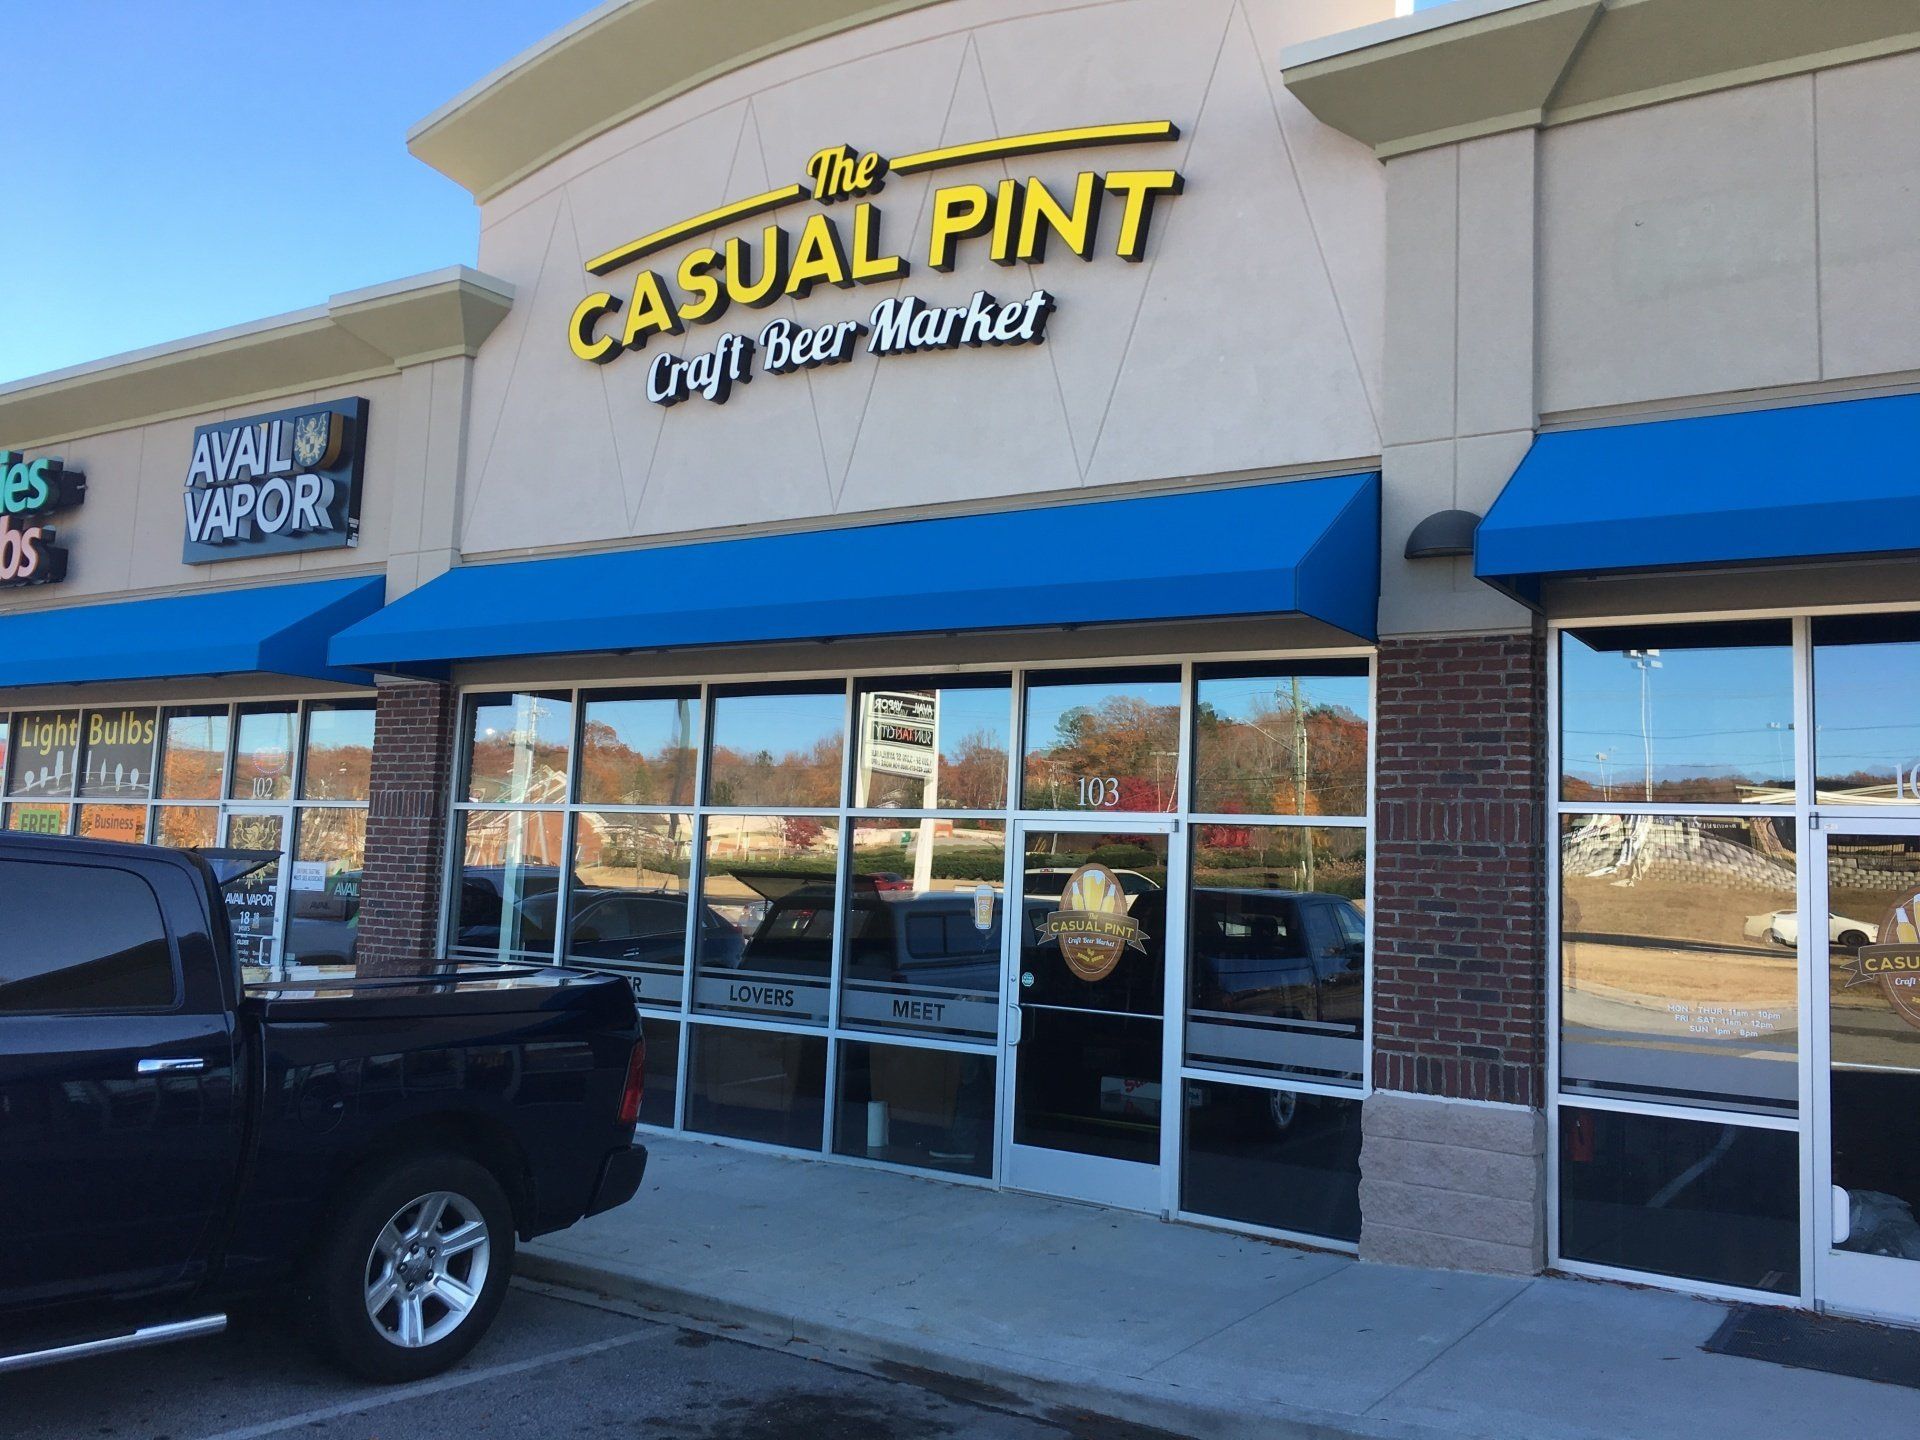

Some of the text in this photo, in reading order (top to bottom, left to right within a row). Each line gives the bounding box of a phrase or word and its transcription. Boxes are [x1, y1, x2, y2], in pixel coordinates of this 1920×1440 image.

[806, 144, 880, 200] The
[568, 170, 1178, 361] CASUAL PINT
[646, 290, 1046, 402] Craft Beer Market
[184, 419, 293, 488] AVAIL
[183, 473, 320, 543] VAPOR
[21, 711, 154, 756] Light Bulbs
[252, 778, 272, 798] 102
[1077, 777, 1119, 806] 103
[20, 813, 56, 833] FREE
[94, 814, 134, 830] Business
[225, 892, 274, 906] AVAIL VAPOR
[334, 882, 360, 896] AVAIL
[240, 911, 250, 924] 18
[1050, 921, 1134, 938] CASUAL PINT
[1865, 956, 1920, 970] CASU
[1895, 977, 1916, 987] Craft
[730, 985, 794, 1007] LOVERS
[892, 1000, 946, 1021] MEET
[1668, 1004, 1688, 1012] MON
[1698, 1006, 1724, 1014] THUR
[1675, 1014, 1689, 1022] FRI
